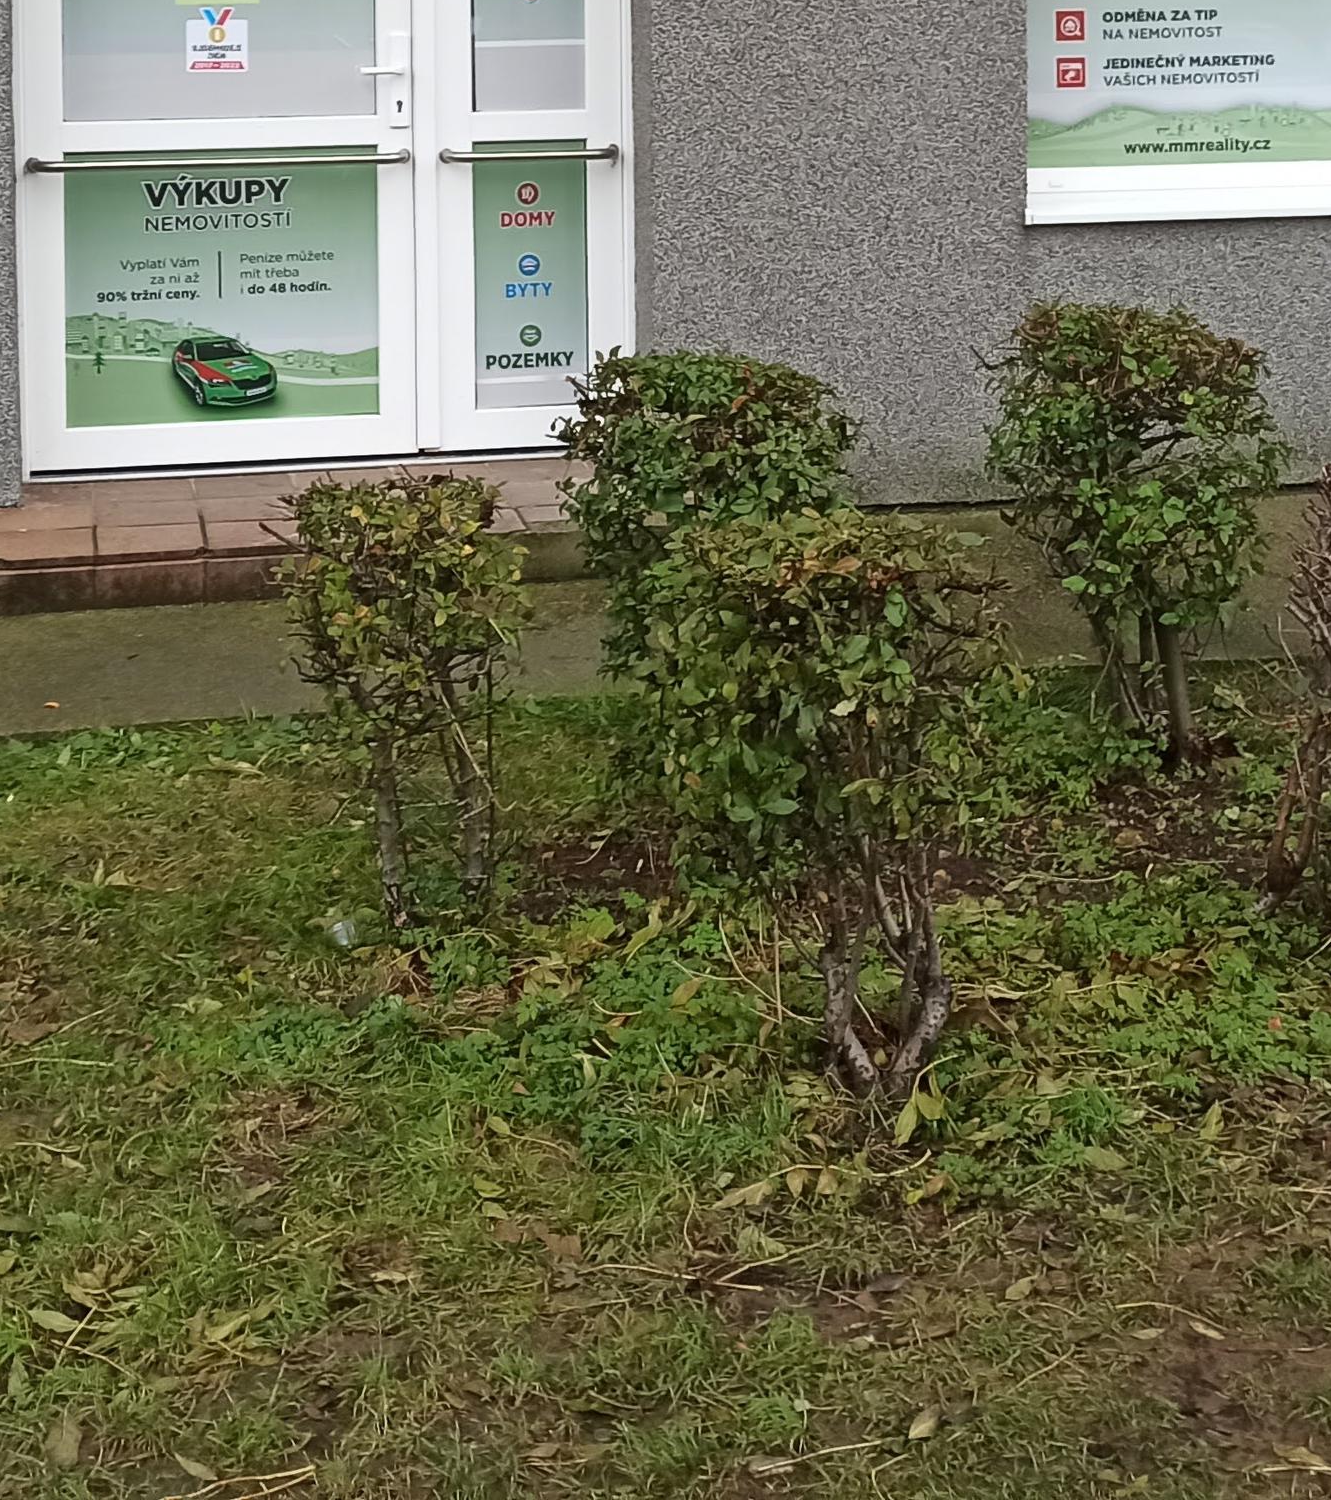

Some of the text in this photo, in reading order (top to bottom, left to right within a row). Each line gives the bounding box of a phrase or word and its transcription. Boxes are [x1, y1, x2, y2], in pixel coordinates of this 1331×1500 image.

[1102, 8, 1218, 24] ODMĚNA ZA TIP
[1102, 25, 1223, 41] NA NEMOVITOST
[1102, 53, 1276, 70] JEDINEČNÝ MARKETING
[1103, 70, 1260, 87] VAŠICH NEMOVITOSTÍ
[1123, 136, 1272, 155] www.mmreality.cz
[141, 173, 292, 209] VÝKUPY
[144, 209, 292, 233] NEMOVITOSTÍ
[500, 211, 555, 228] DOMY
[120, 257, 200, 272] Vyplatí Vám
[286, 251, 335, 262] můžete
[150, 275, 165, 285] za
[184, 273, 200, 283] až
[264, 267, 300, 279] třeba
[96, 289, 200, 303] 90% tržní ceny.
[247, 284, 265, 295] do
[269, 282, 286, 293] 48
[290, 281, 332, 292] hodin.
[505, 282, 553, 299] BYTY
[485, 351, 574, 370] POZEMKY
